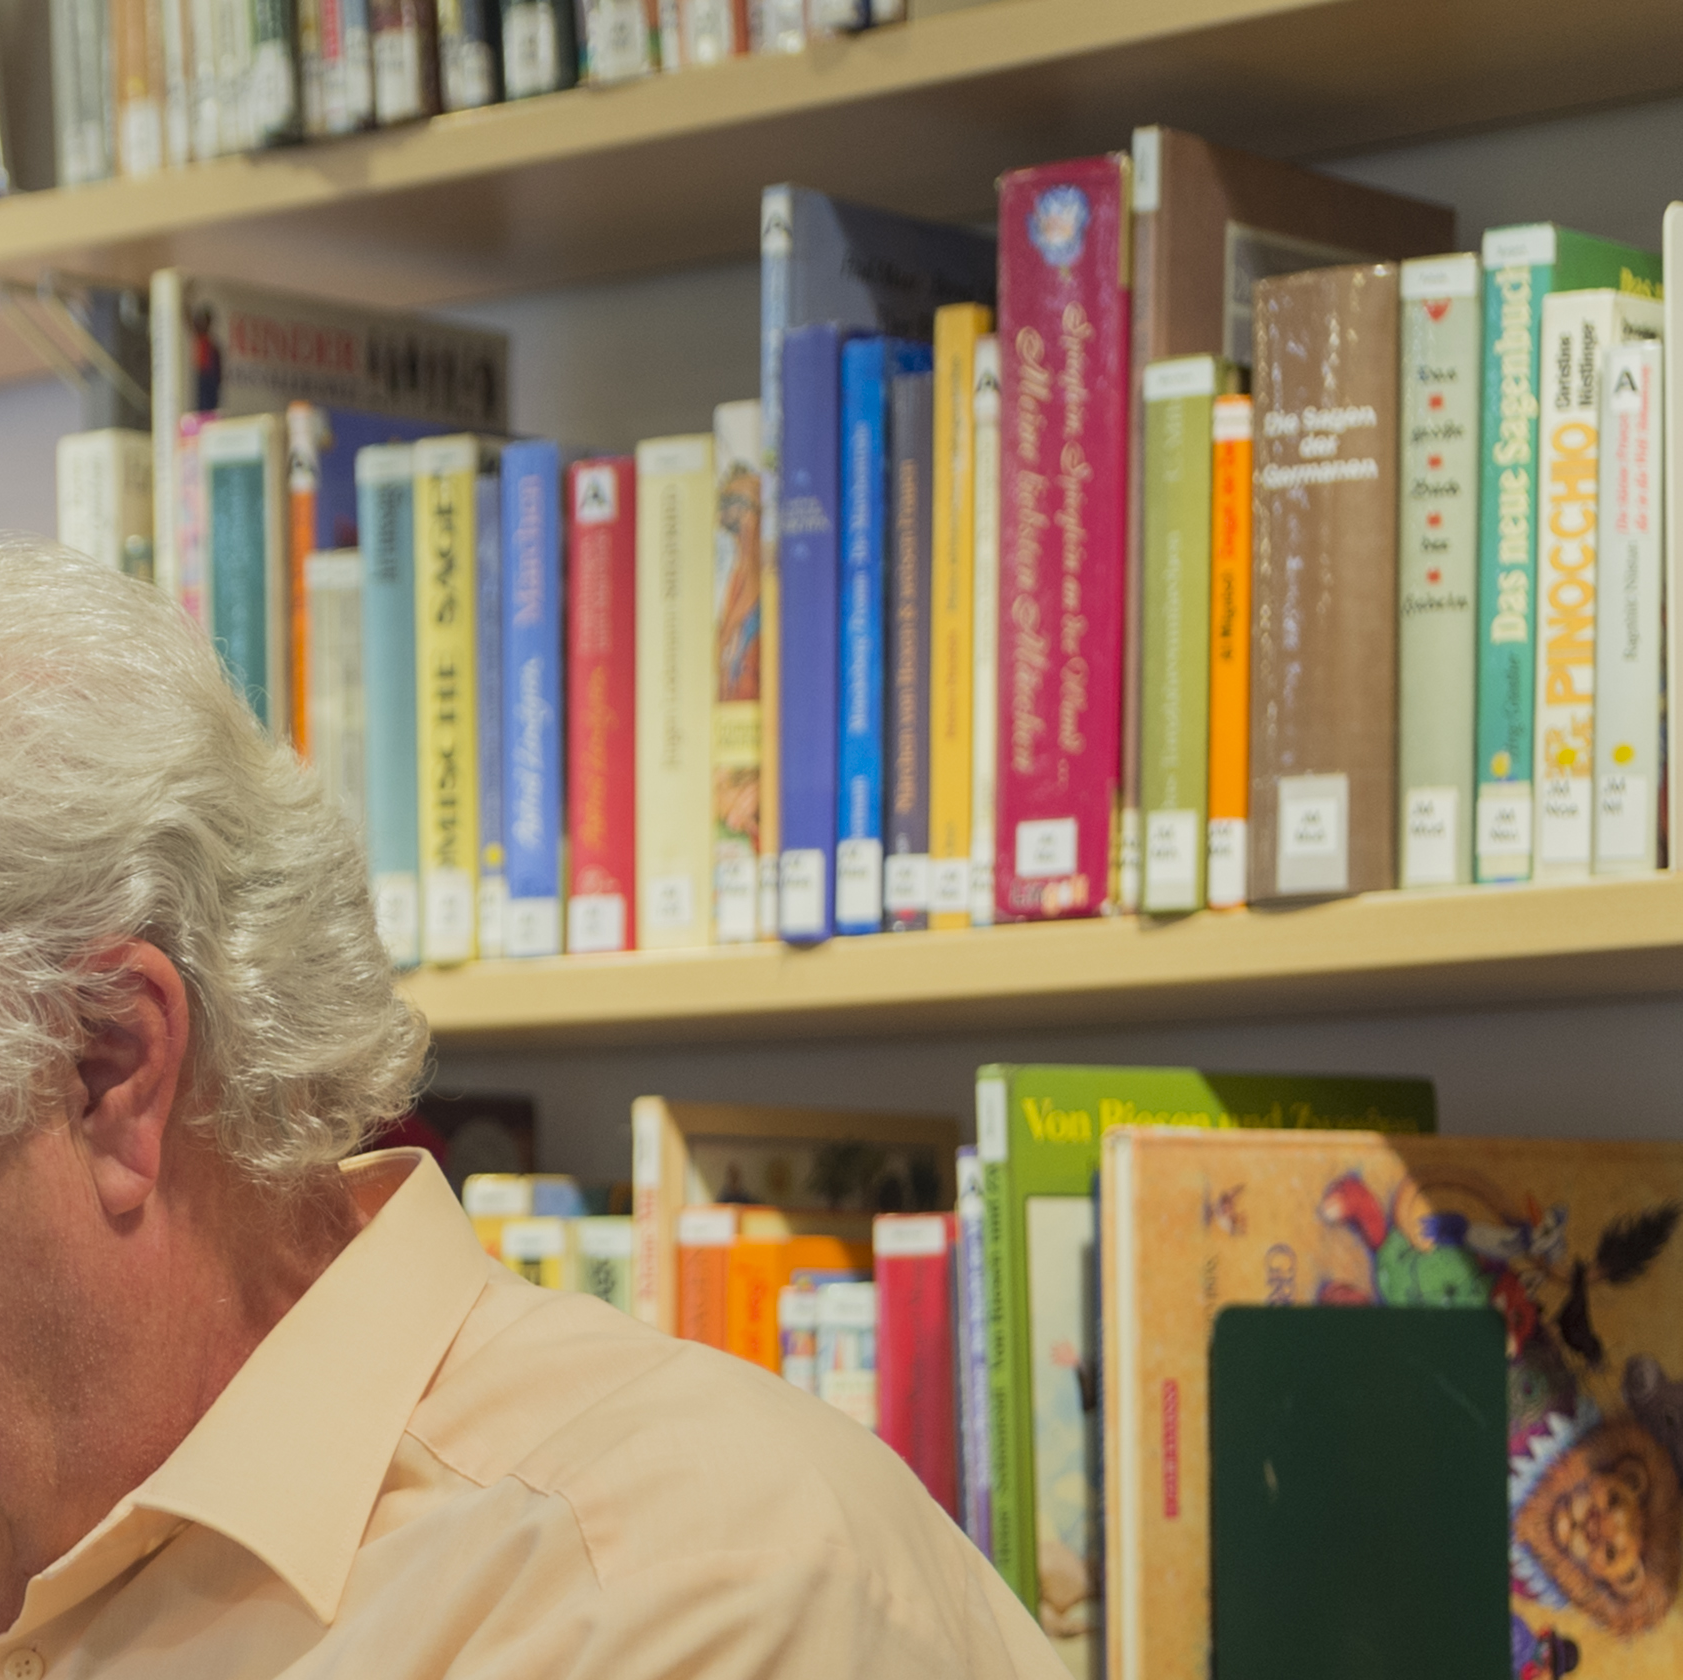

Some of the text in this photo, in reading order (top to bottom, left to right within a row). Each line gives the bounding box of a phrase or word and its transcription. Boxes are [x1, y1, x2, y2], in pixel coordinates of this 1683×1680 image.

[1263, 402, 1378, 438] Die Sagen
[1299, 430, 1338, 459] der
[1492, 265, 1539, 644] Das neue Sagenbuch
[1261, 455, 1380, 489] Germanen
[1546, 421, 1598, 705] PINOCCHIO
[1021, 1096, 1093, 1144] Von
